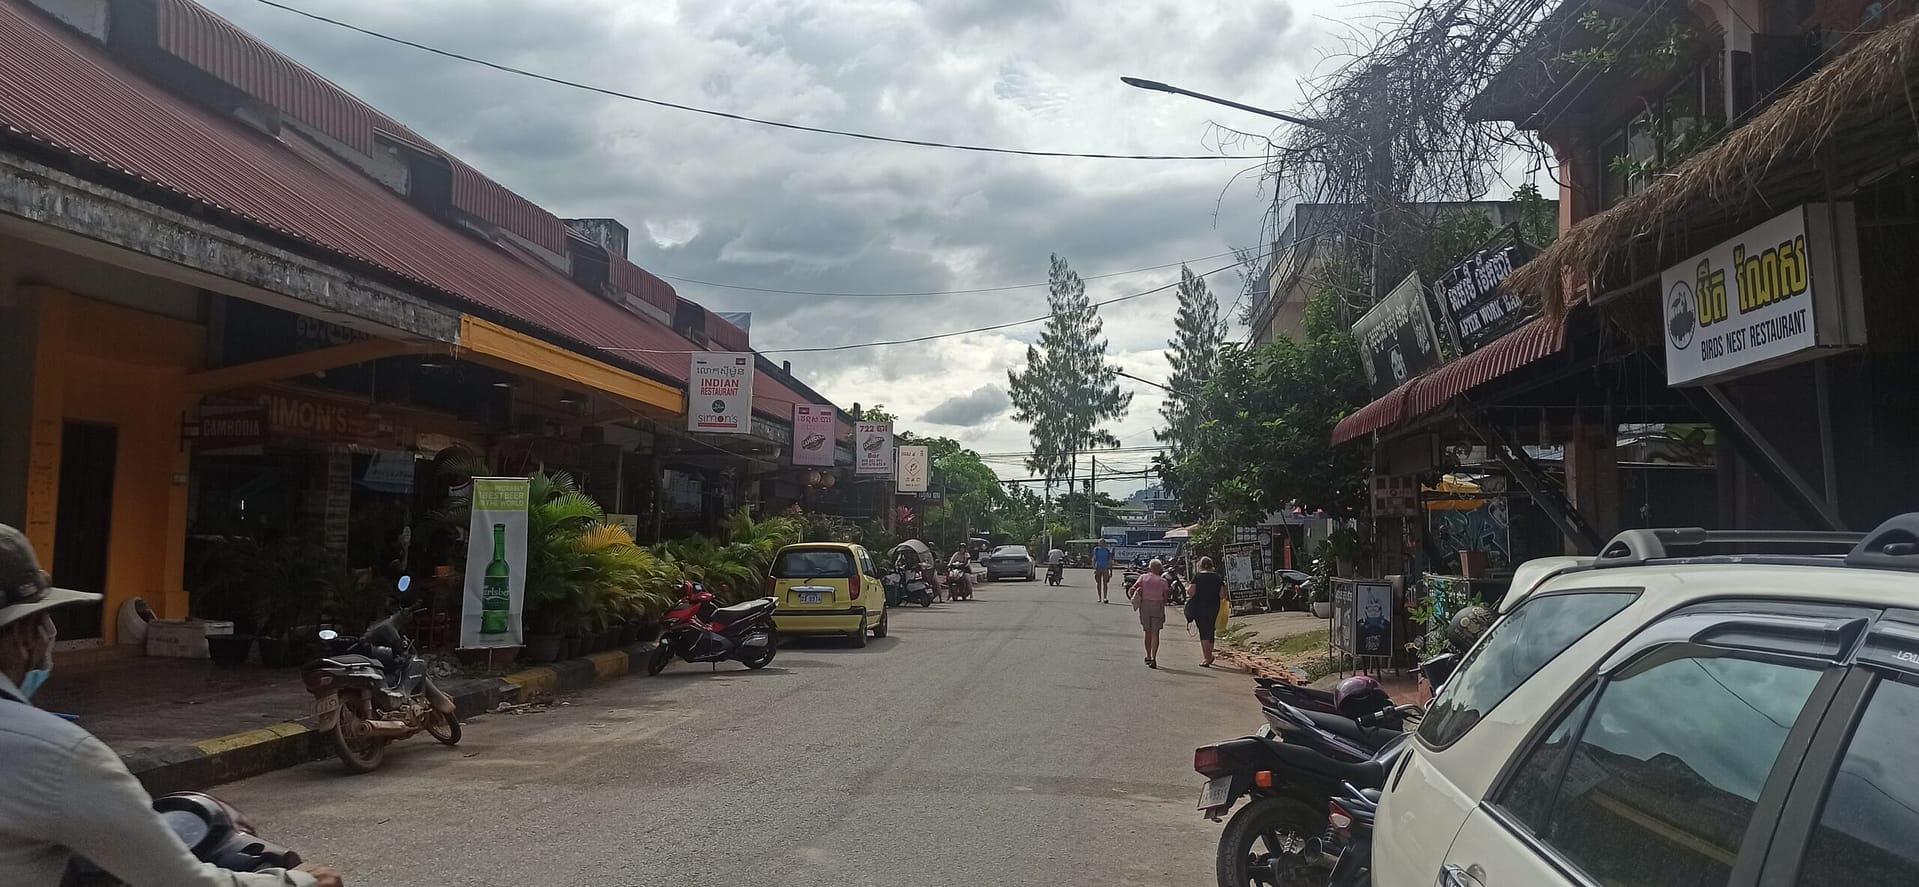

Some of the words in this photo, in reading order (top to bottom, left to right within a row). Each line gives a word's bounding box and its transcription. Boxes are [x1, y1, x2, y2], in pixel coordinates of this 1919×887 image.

[1458, 310, 1482, 338] AFTER
[1479, 298, 1504, 326] WORK
[1701, 336, 1724, 362] BIRDS
[1726, 327, 1746, 354] NEST
[1750, 309, 1807, 348] RESTAURANT
[701, 378, 739, 388] INDIAN
[700, 387, 739, 397] RESTAURANT
[698, 414, 738, 424] simon's
[203, 417, 260, 437] CAMBODIA
[859, 425, 874, 433] 722
[483, 584, 511, 597] arlsber
